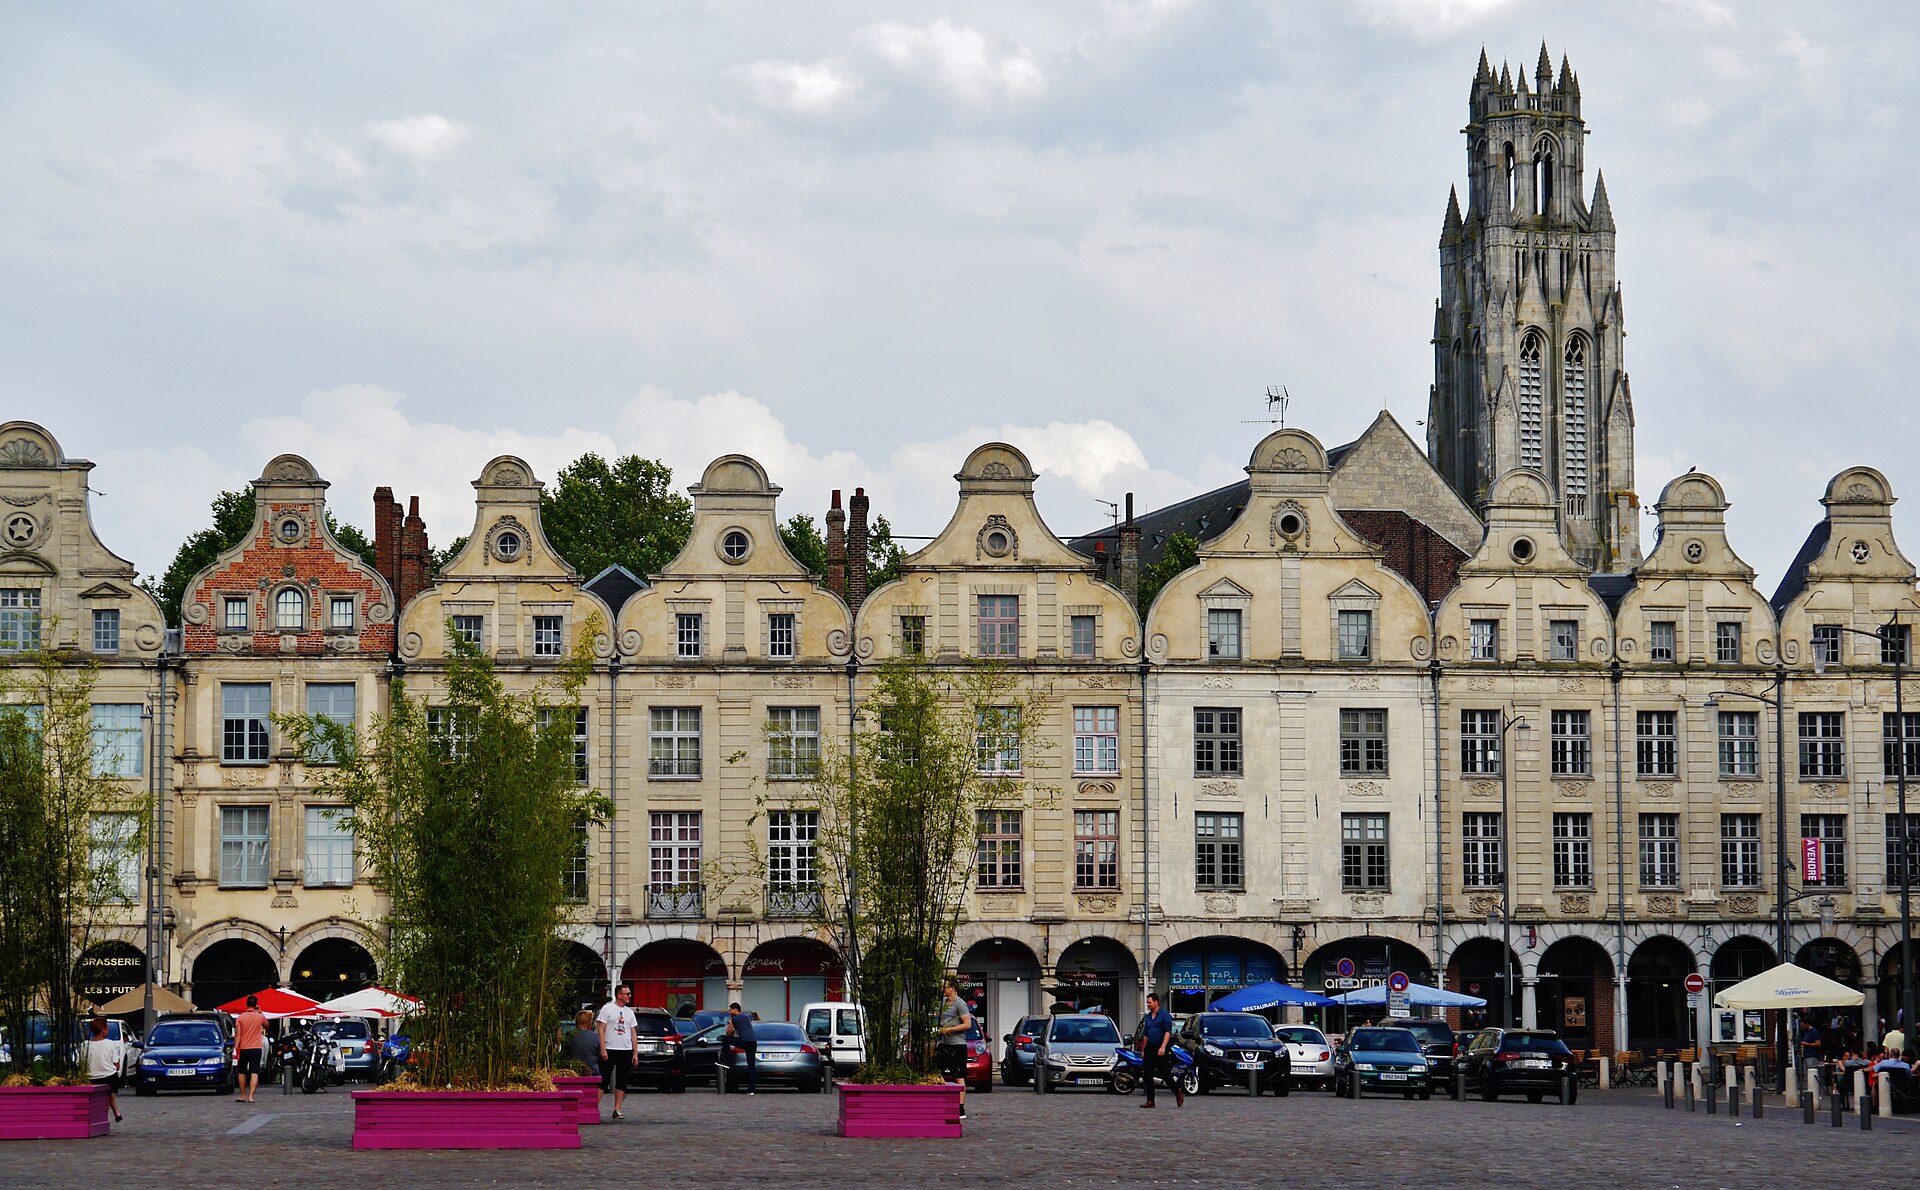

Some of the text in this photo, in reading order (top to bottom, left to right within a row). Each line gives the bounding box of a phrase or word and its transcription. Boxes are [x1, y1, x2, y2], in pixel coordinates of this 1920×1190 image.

[1807, 847, 1817, 880] VENDRE
[82, 957, 142, 966] BRASSERIE
[84, 986, 103, 994] LES
[104, 986, 111, 994] 3
[1241, 1000, 1280, 1012] RESTAURANT
